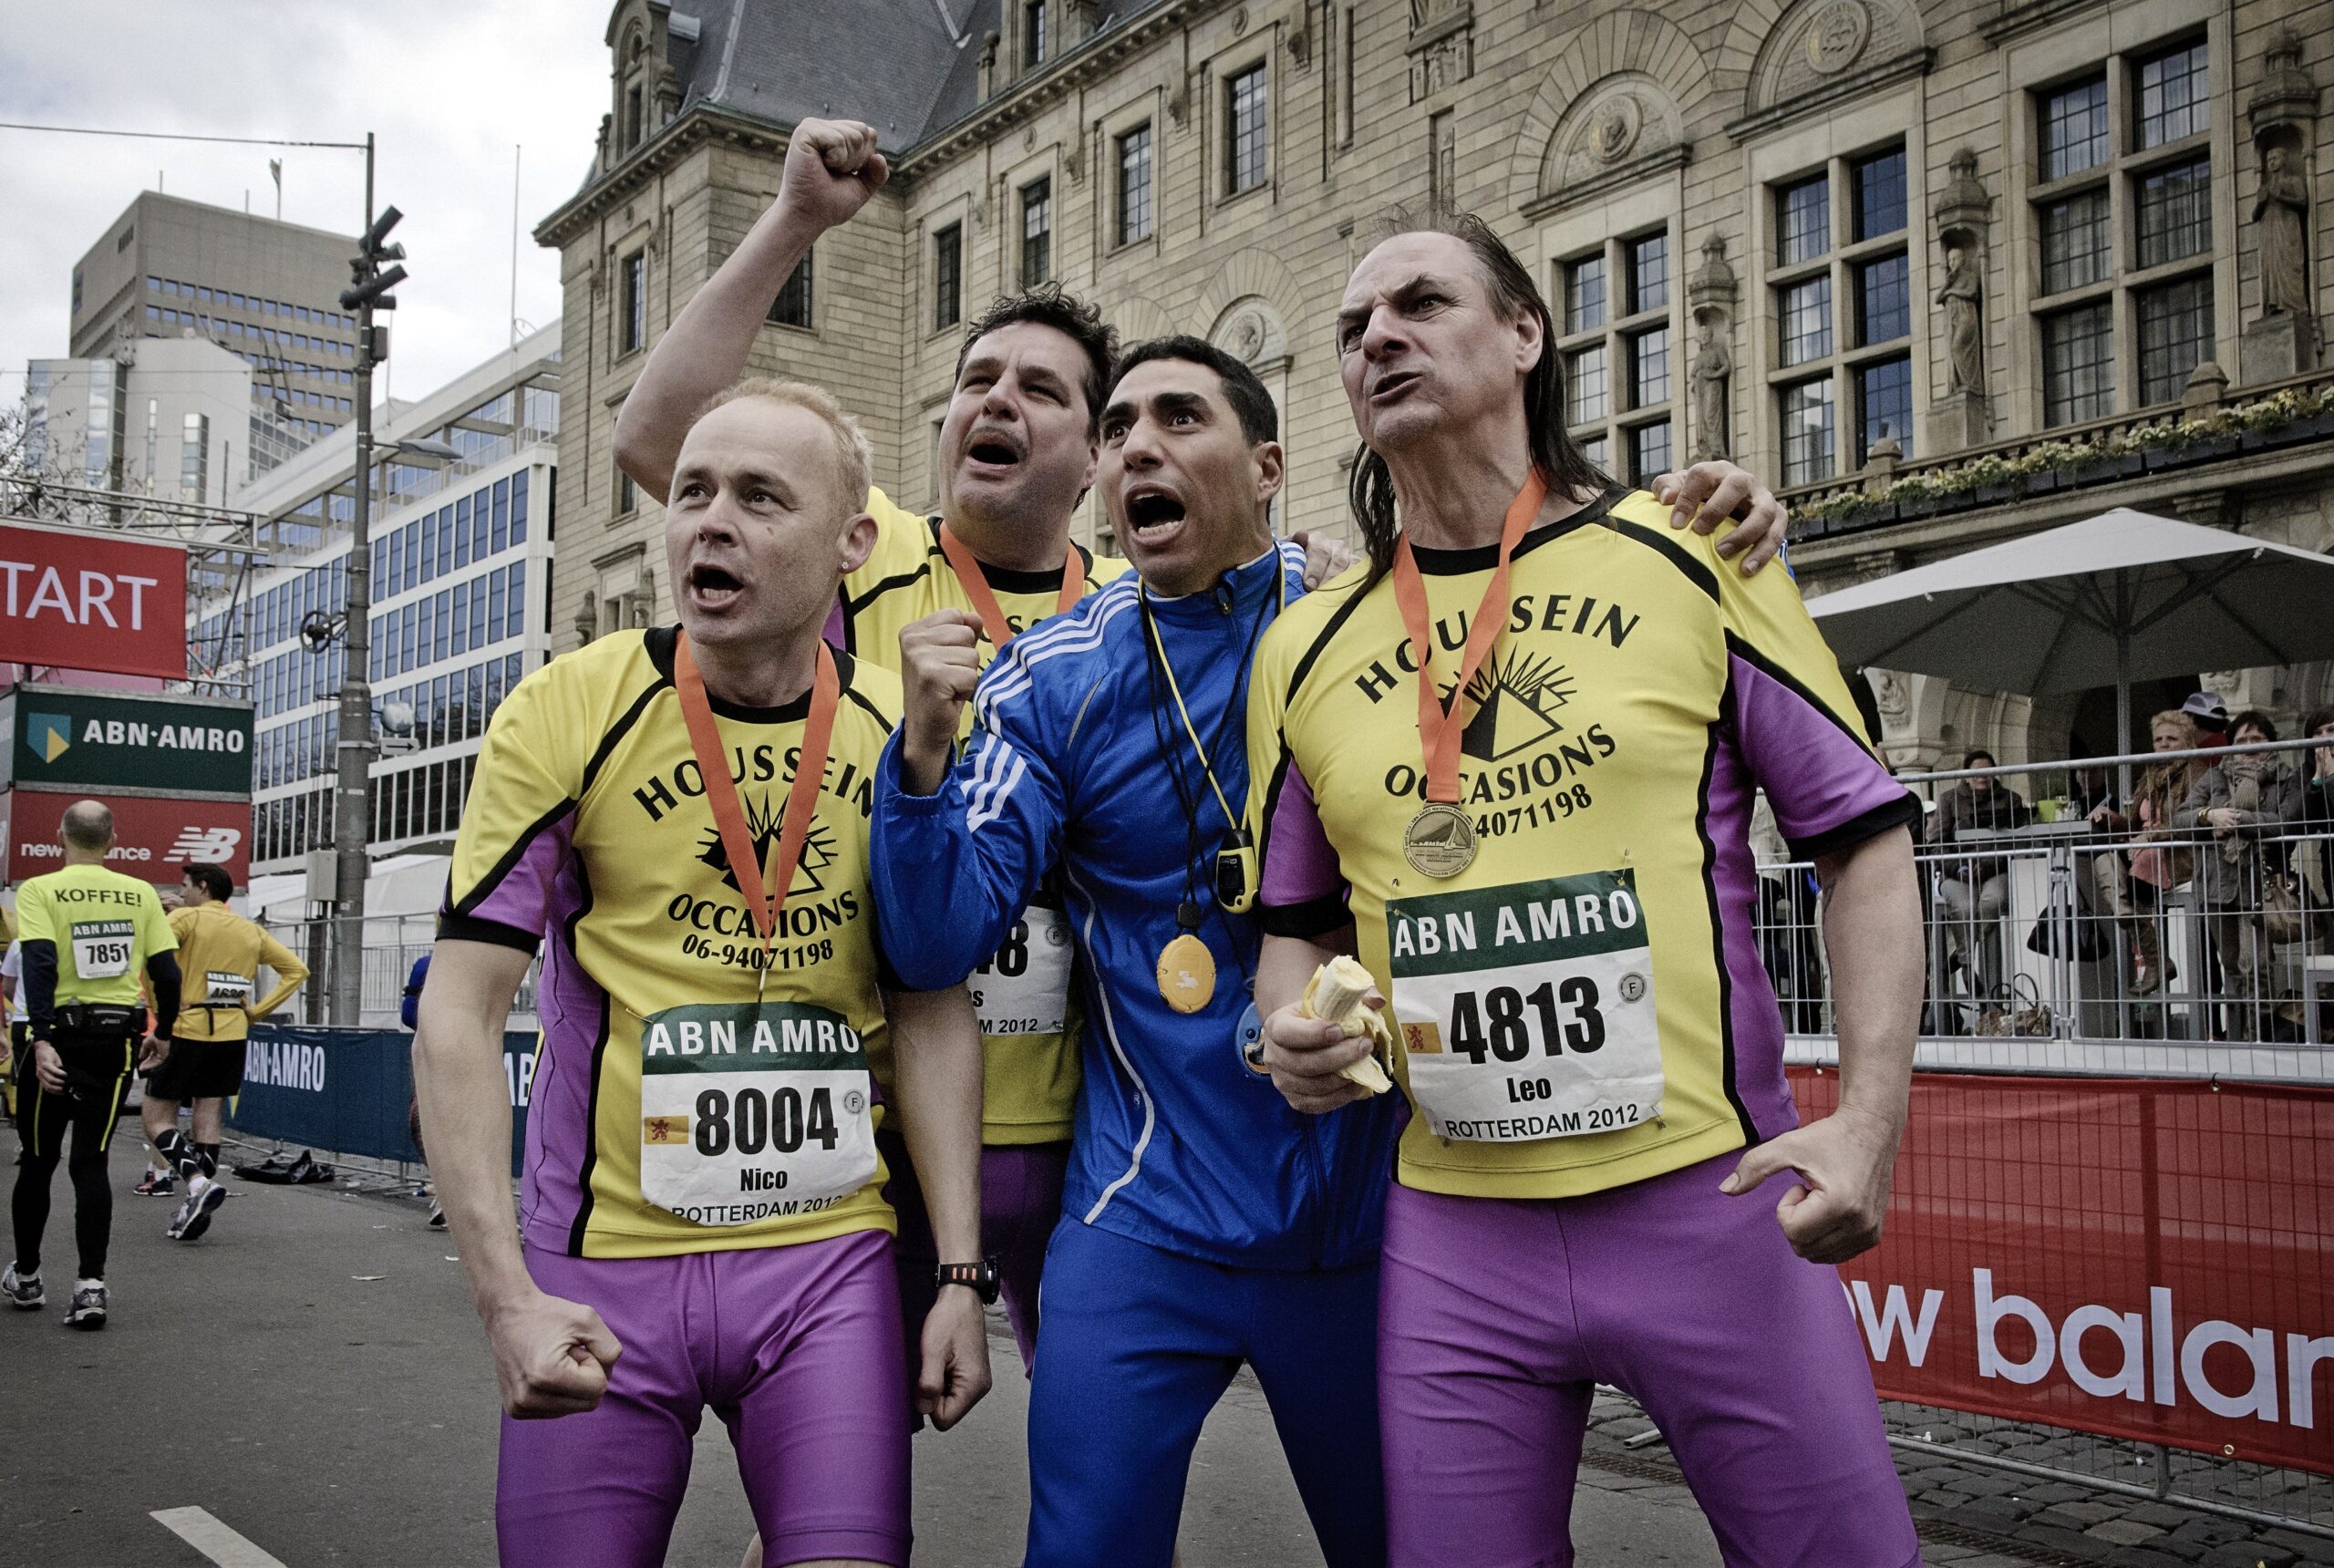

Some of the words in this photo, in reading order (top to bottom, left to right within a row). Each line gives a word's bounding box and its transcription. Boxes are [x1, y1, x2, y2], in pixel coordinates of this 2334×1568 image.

[0, 561, 158, 631] TART
[1354, 594, 1641, 705] HOUSEIN
[1470, 783, 1593, 838] 4071198
[21, 843, 63, 858] new
[103, 846, 151, 861] ance
[55, 889, 141, 907] KOFFIE!
[74, 924, 100, 936] ABN
[102, 923, 134, 934] AMRO
[1394, 911, 1477, 957] ABN
[1495, 890, 1637, 947] AMRO
[86, 943, 130, 965] 7851
[647, 1020, 737, 1057] ABN
[751, 1019, 860, 1054] AMRO
[998, 1018, 1038, 1033] 2012
[1450, 975, 1606, 1065] 4813
[1506, 1078, 1552, 1104] Leo
[695, 1087, 839, 1157] 8004
[1444, 1112, 1582, 1139] ROTTERDAM
[1587, 1103, 1639, 1129] 2012
[740, 1168, 788, 1191] Nico
